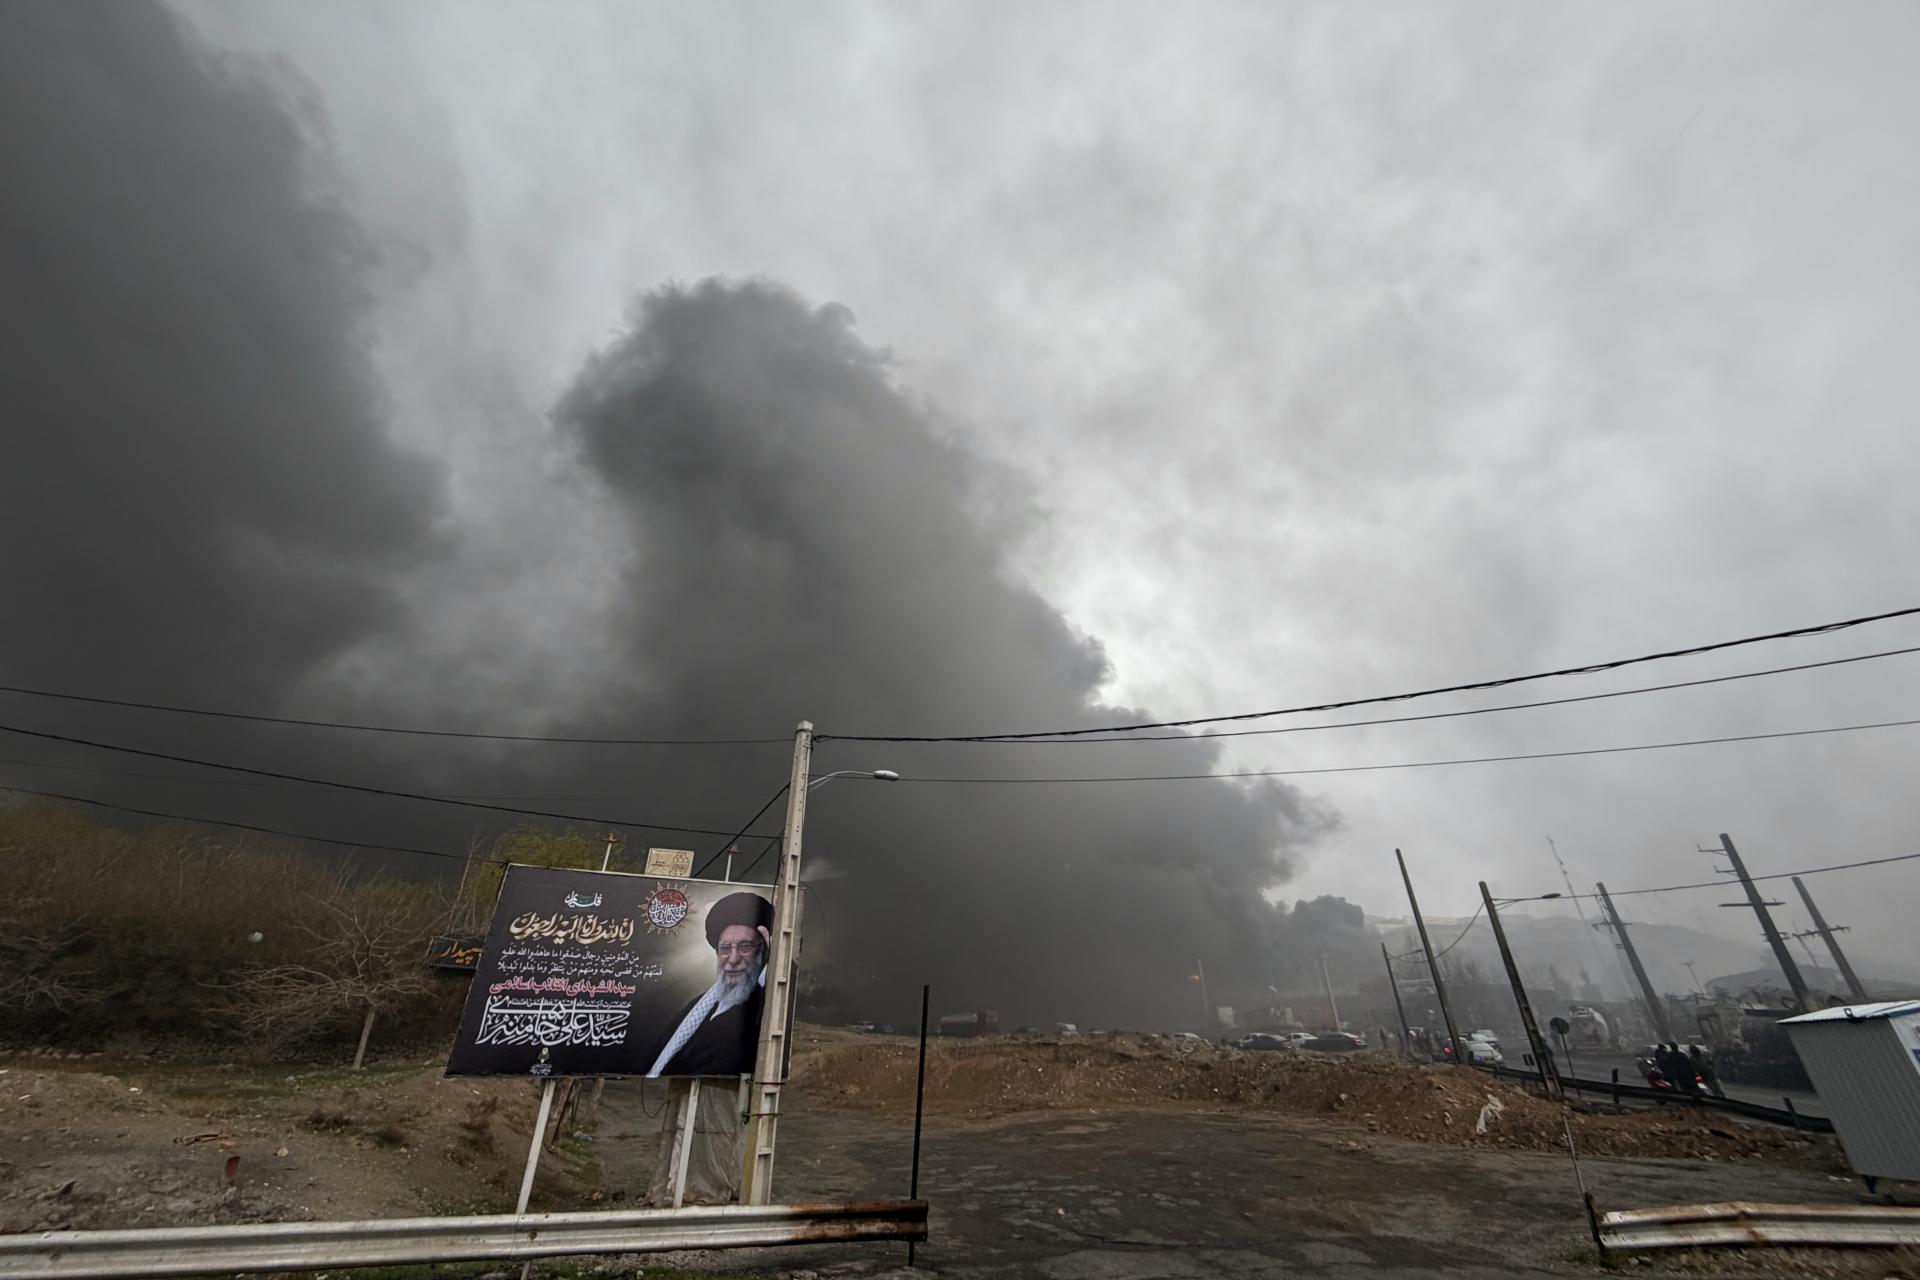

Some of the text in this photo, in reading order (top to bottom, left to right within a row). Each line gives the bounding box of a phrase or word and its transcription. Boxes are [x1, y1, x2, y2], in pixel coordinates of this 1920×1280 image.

[489, 975, 535, 994] اسلامی
[532, 976, 569, 995] انقلاب
[614, 981, 636, 997] سید
[573, 1013, 628, 1047] سید
